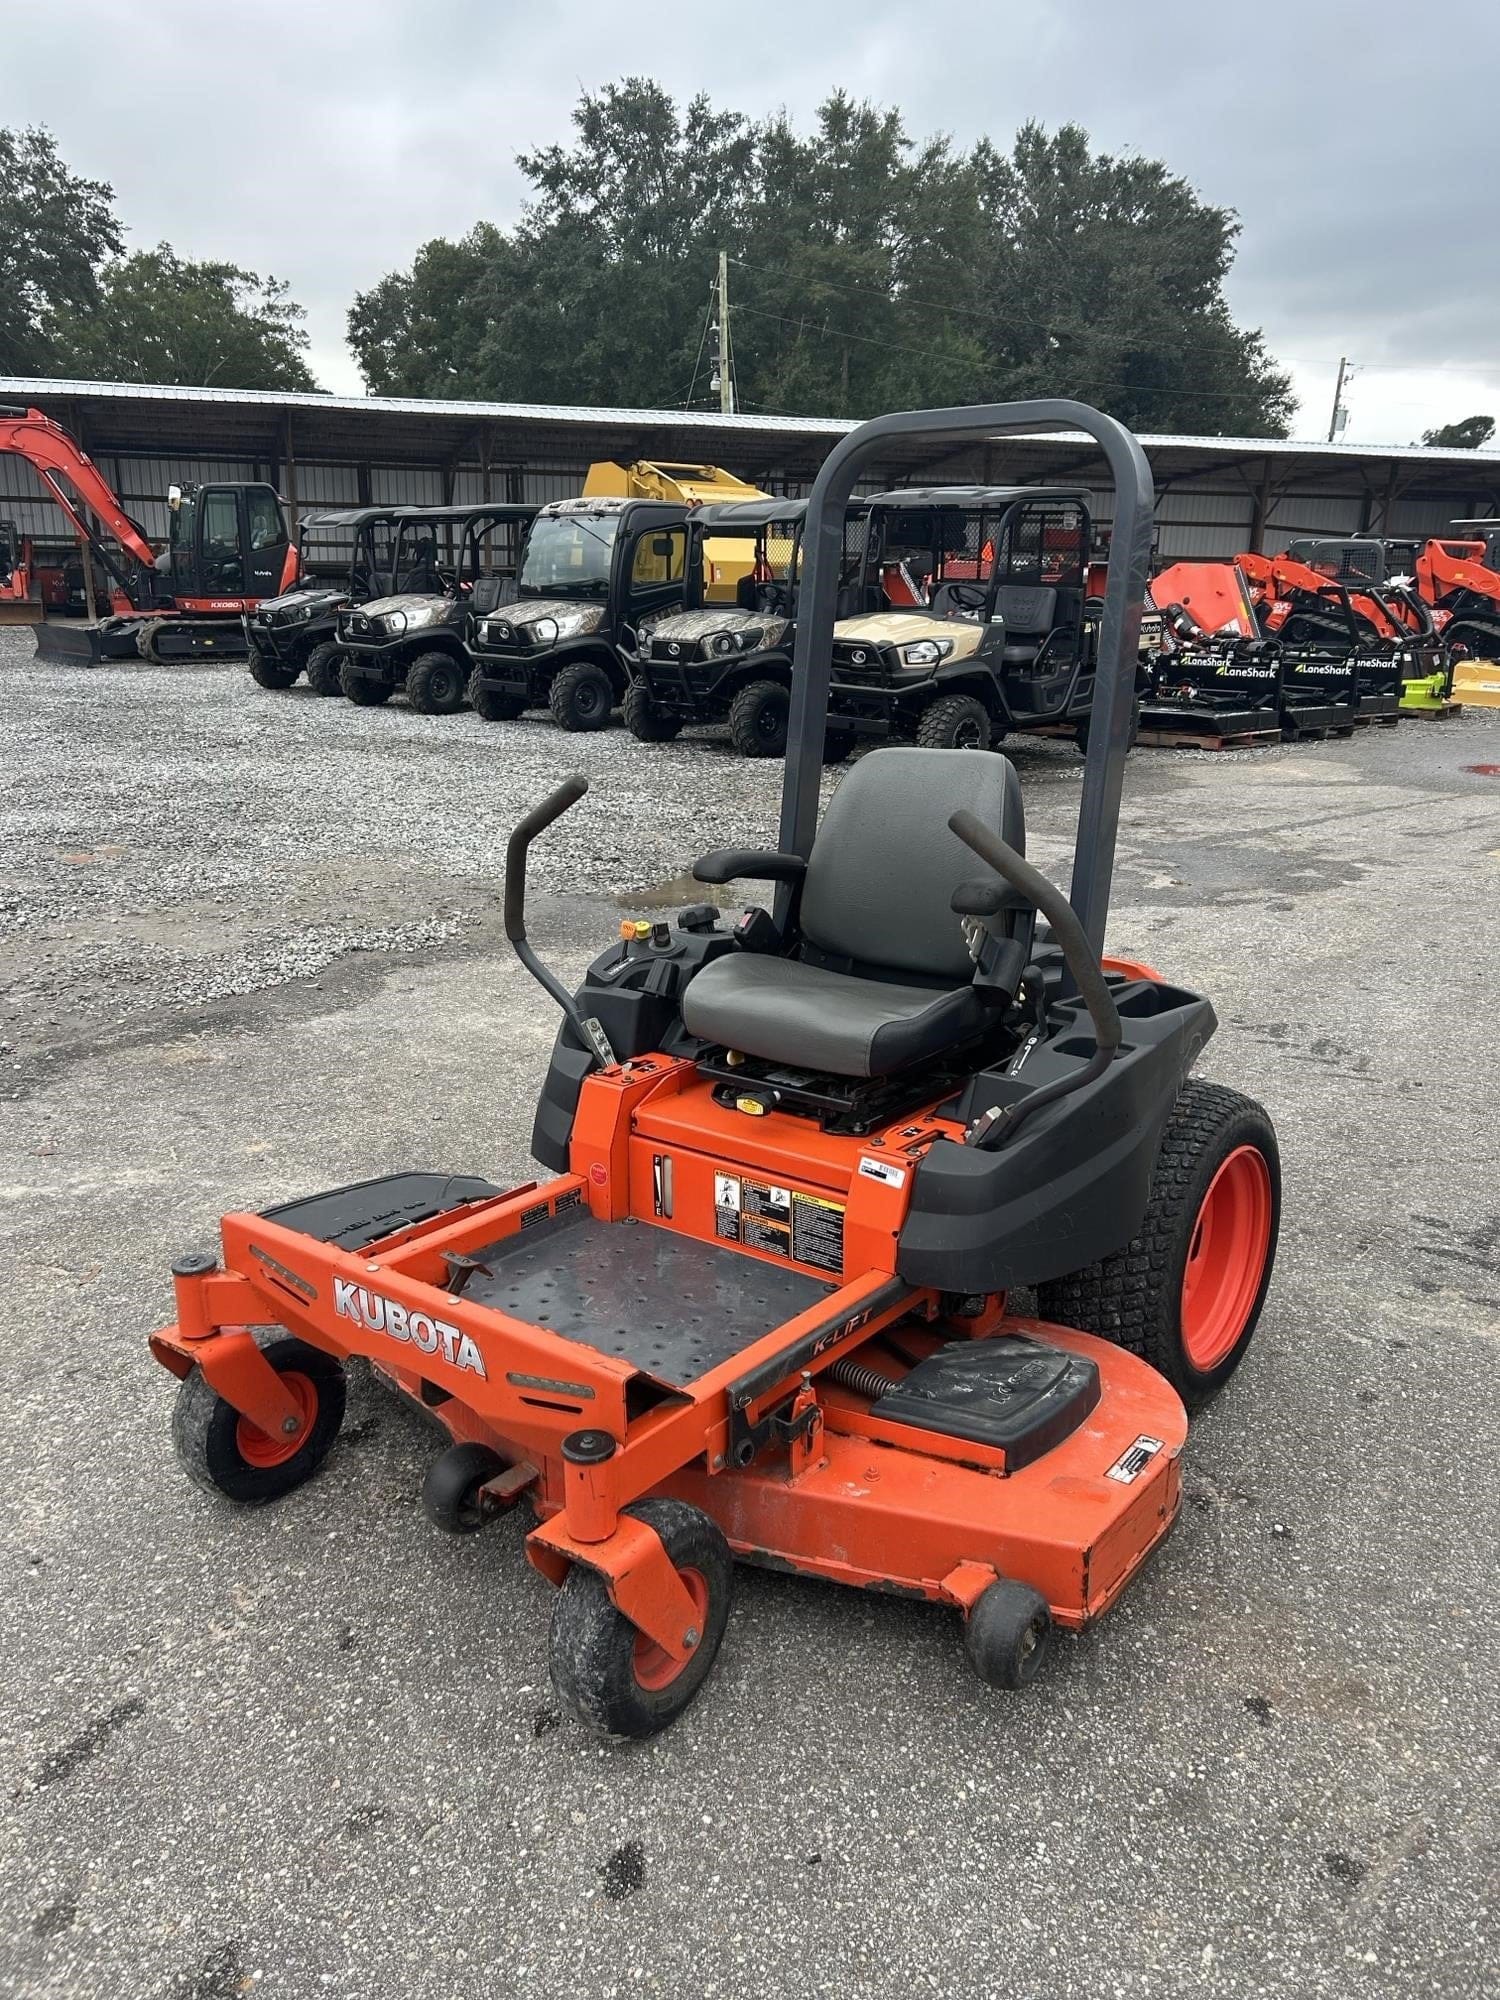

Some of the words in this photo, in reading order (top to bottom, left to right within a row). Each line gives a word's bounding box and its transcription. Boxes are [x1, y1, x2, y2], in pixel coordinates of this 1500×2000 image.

[1187, 656, 1232, 667] LaneShark
[1356, 658, 1398, 669] neShark
[1224, 666, 1276, 679] LaneShark
[1302, 664, 1352, 676] LaneShark
[333, 1276, 488, 1382] KUBOTA
[813, 1307, 873, 1356] K-LIFT
